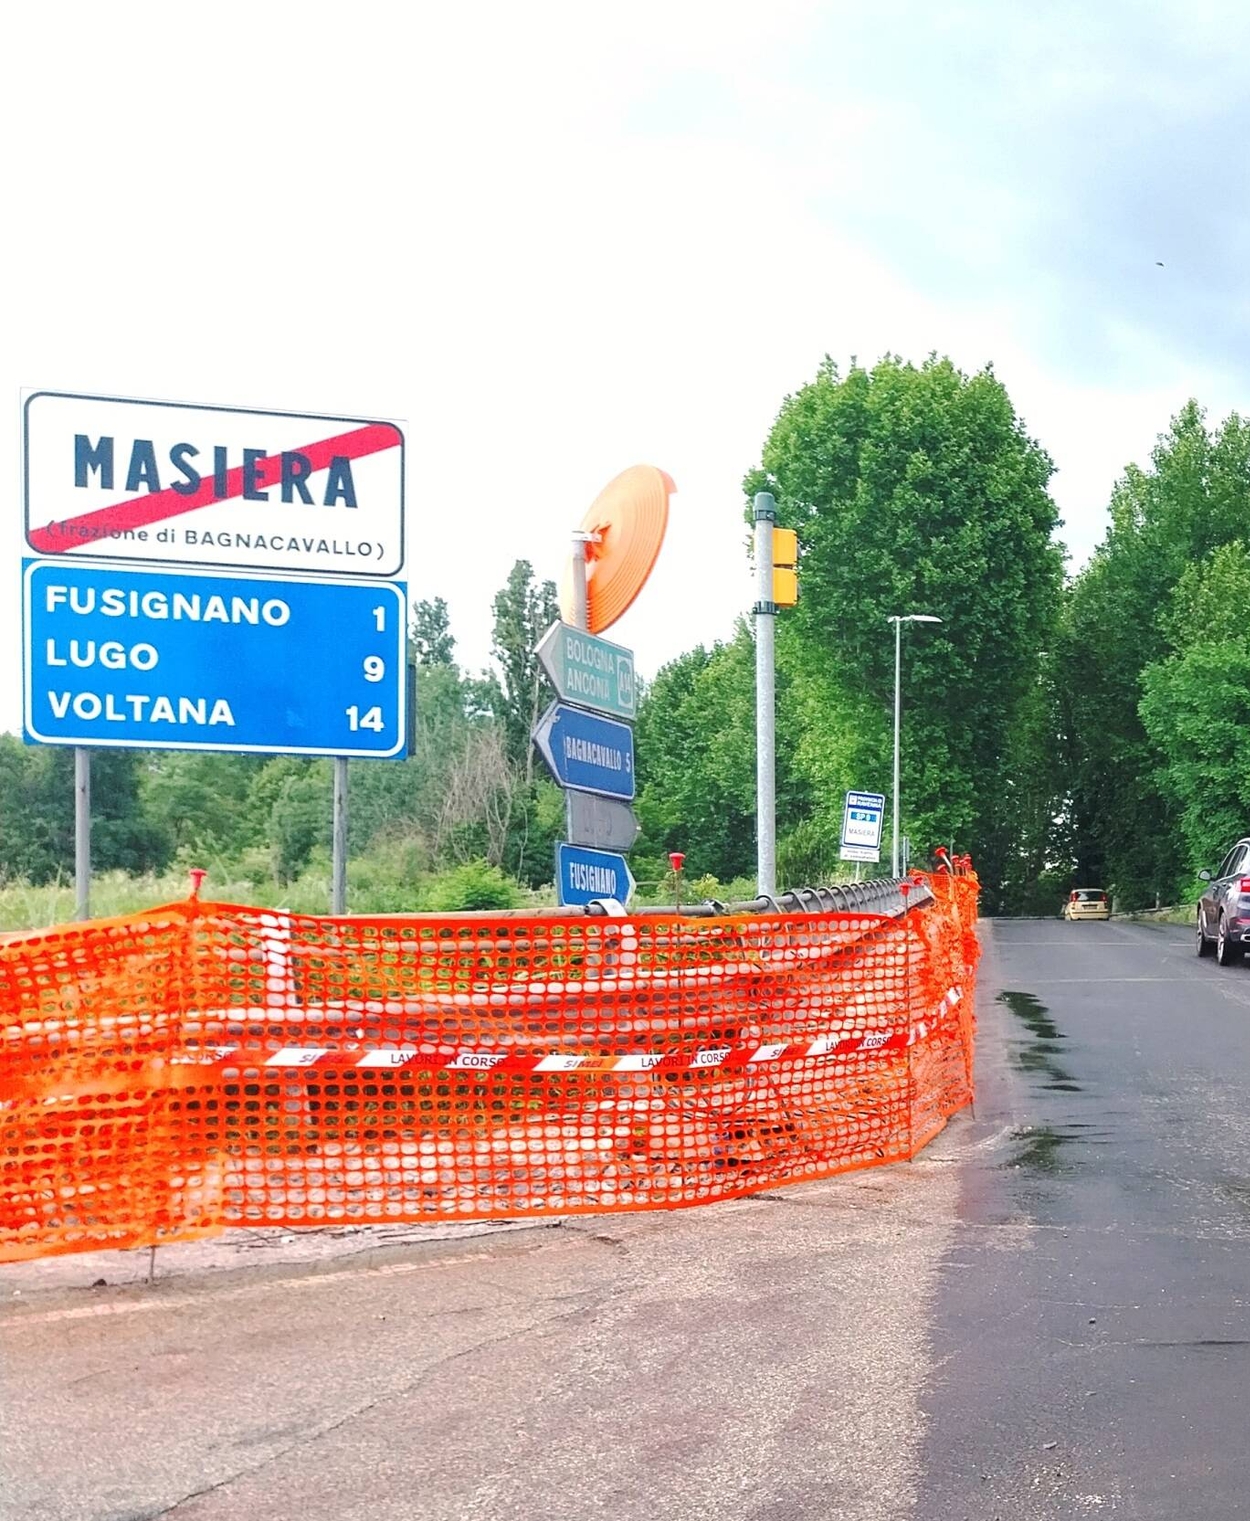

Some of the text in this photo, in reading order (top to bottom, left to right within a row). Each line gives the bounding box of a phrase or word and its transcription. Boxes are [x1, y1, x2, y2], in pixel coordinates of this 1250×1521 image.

[74, 433, 358, 509] MASIERA
[156, 528, 176, 544] di
[185, 530, 384, 560] BAGNACAVALLO)
[46, 586, 385, 632] FUSIGNANO 1
[46, 639, 385, 682] LUGO 9
[567, 637, 615, 674] BOLOGNA
[567, 667, 611, 701] ANCONA
[48, 691, 385, 733] VOLTANA 14
[566, 736, 631, 773] BAGNACAVALLO 5
[570, 862, 616, 895] FUSIGNANO
[462, 1056, 505, 1068] CORSO
[641, 1055, 684, 1068] LAVORI
[700, 1051, 731, 1064] CORSO
